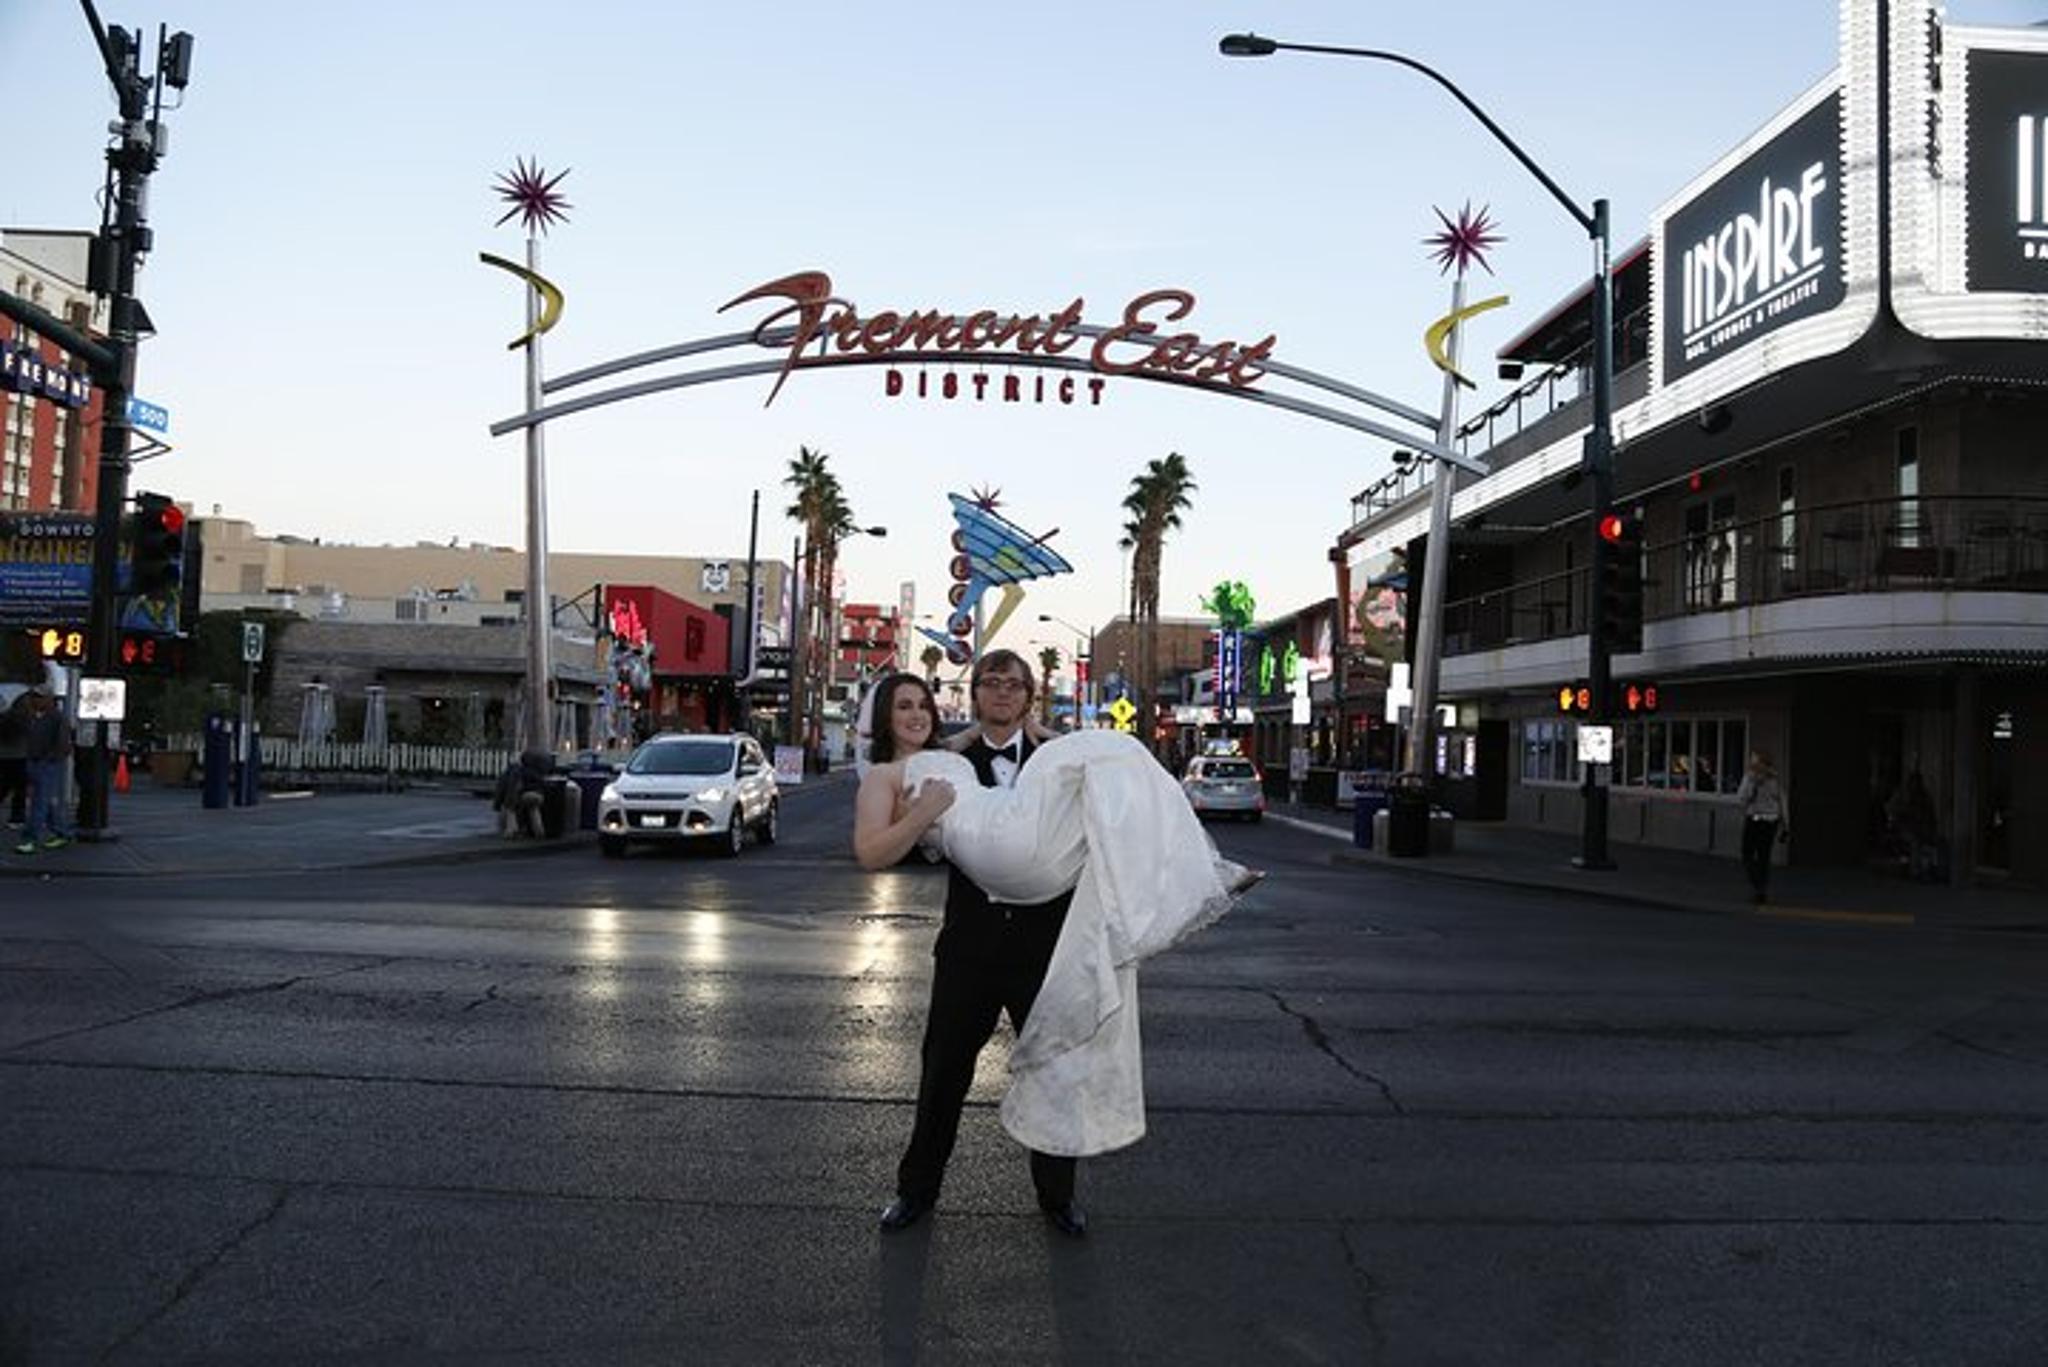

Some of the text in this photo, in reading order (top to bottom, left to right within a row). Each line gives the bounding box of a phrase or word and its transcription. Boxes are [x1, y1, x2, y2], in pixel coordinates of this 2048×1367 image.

[1683, 161, 1827, 335] INSPIRE
[4, 352, 91, 401] FREMONT
[717, 270, 1277, 408] Fremont East
[886, 369, 1105, 406] DISTRICT
